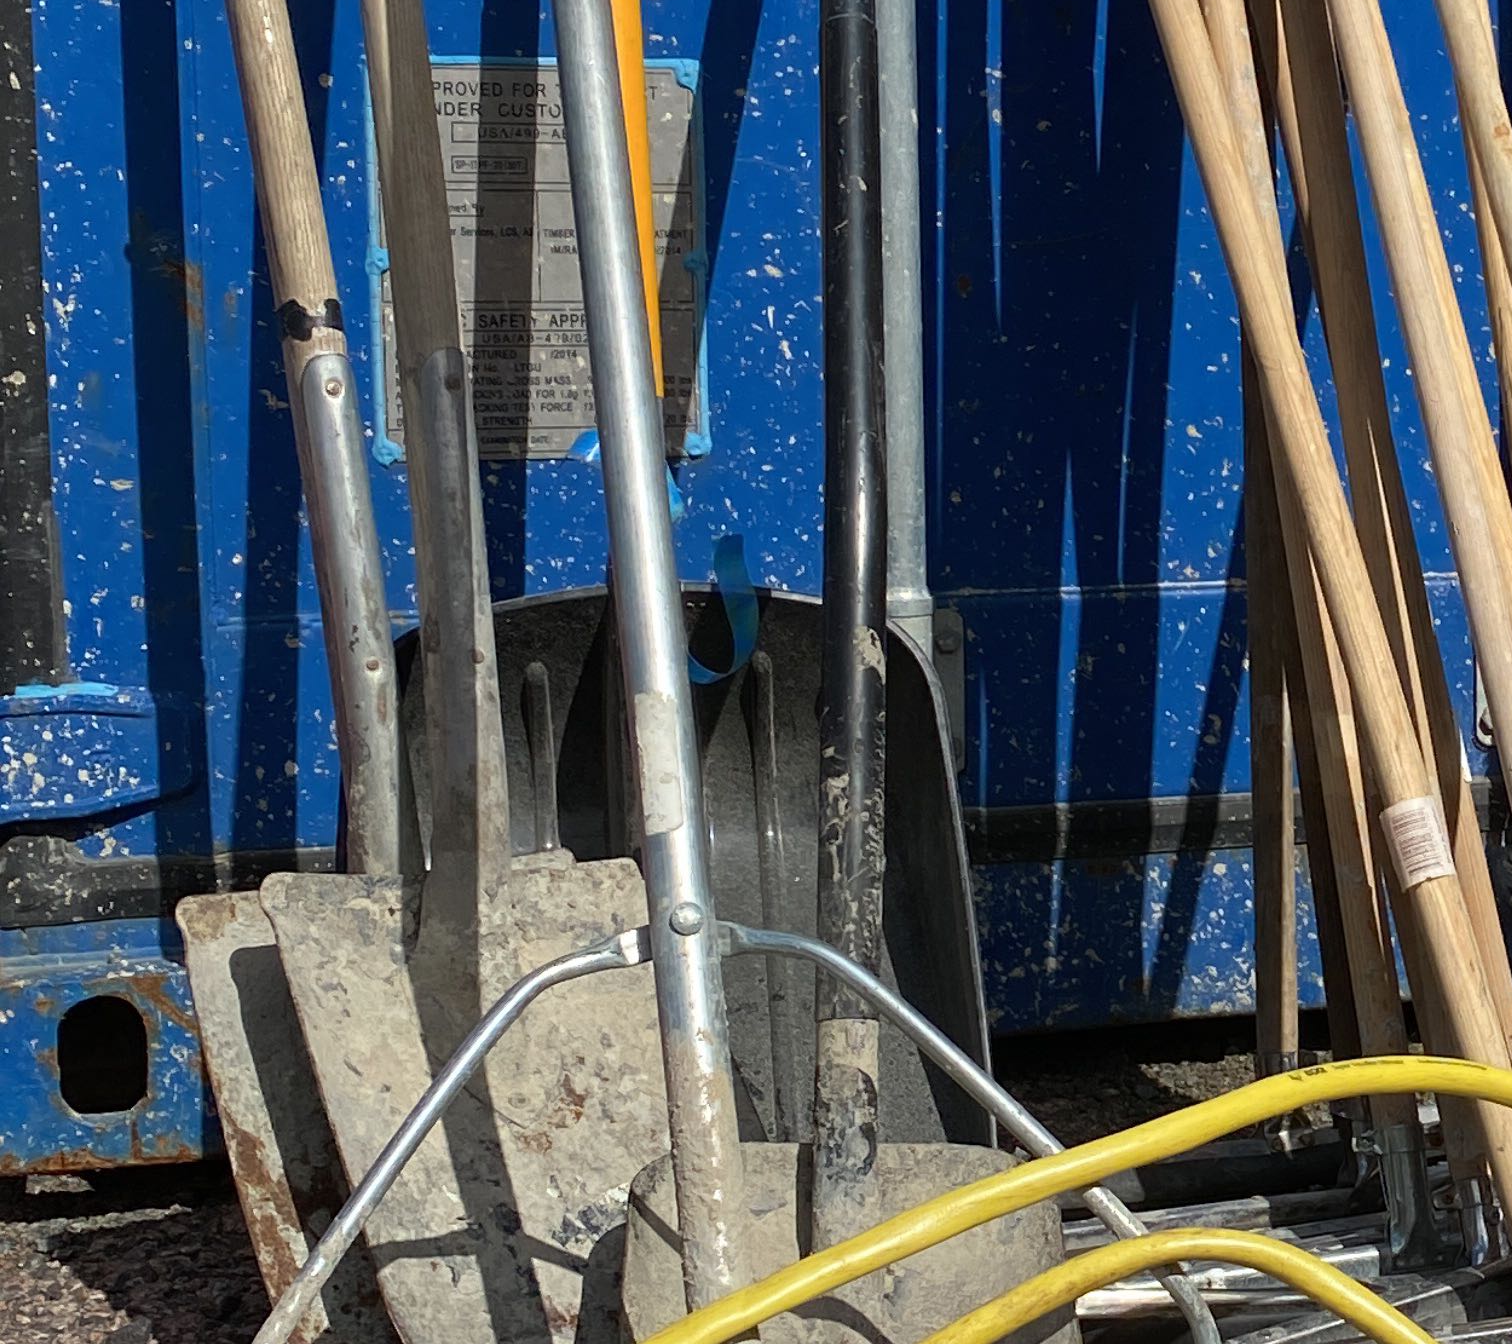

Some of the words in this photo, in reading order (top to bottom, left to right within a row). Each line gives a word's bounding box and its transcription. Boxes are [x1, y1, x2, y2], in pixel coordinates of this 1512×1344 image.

[432, 81, 503, 97] PROVED
[512, 82, 546, 98] FOR
[434, 101, 482, 117] NDER
[497, 102, 562, 119] CUSTO
[478, 313, 537, 328] SAFETY
[540, 403, 573, 412] FORCE
